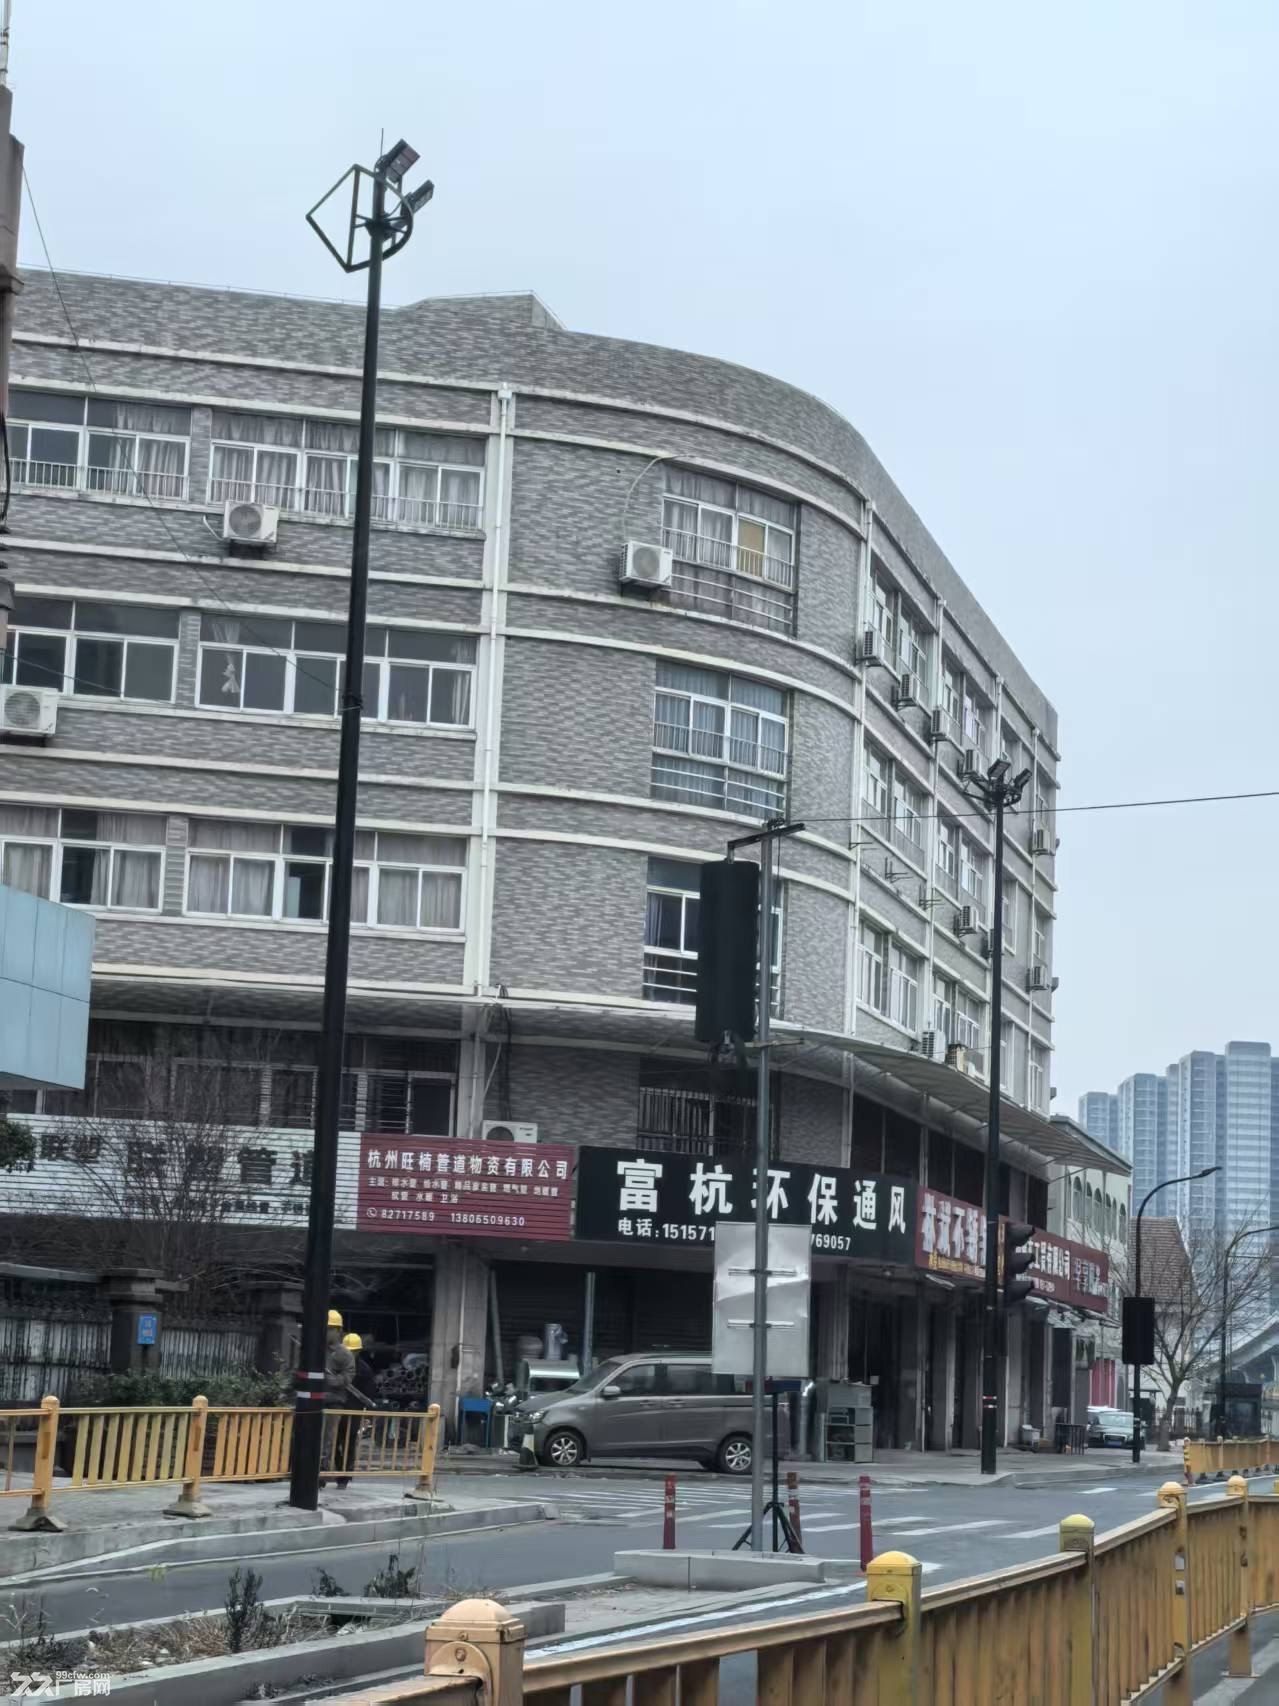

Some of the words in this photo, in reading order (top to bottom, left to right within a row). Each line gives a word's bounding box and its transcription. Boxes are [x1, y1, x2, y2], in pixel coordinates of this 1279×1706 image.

[616, 1158, 907, 1235] 富杭环保通风
